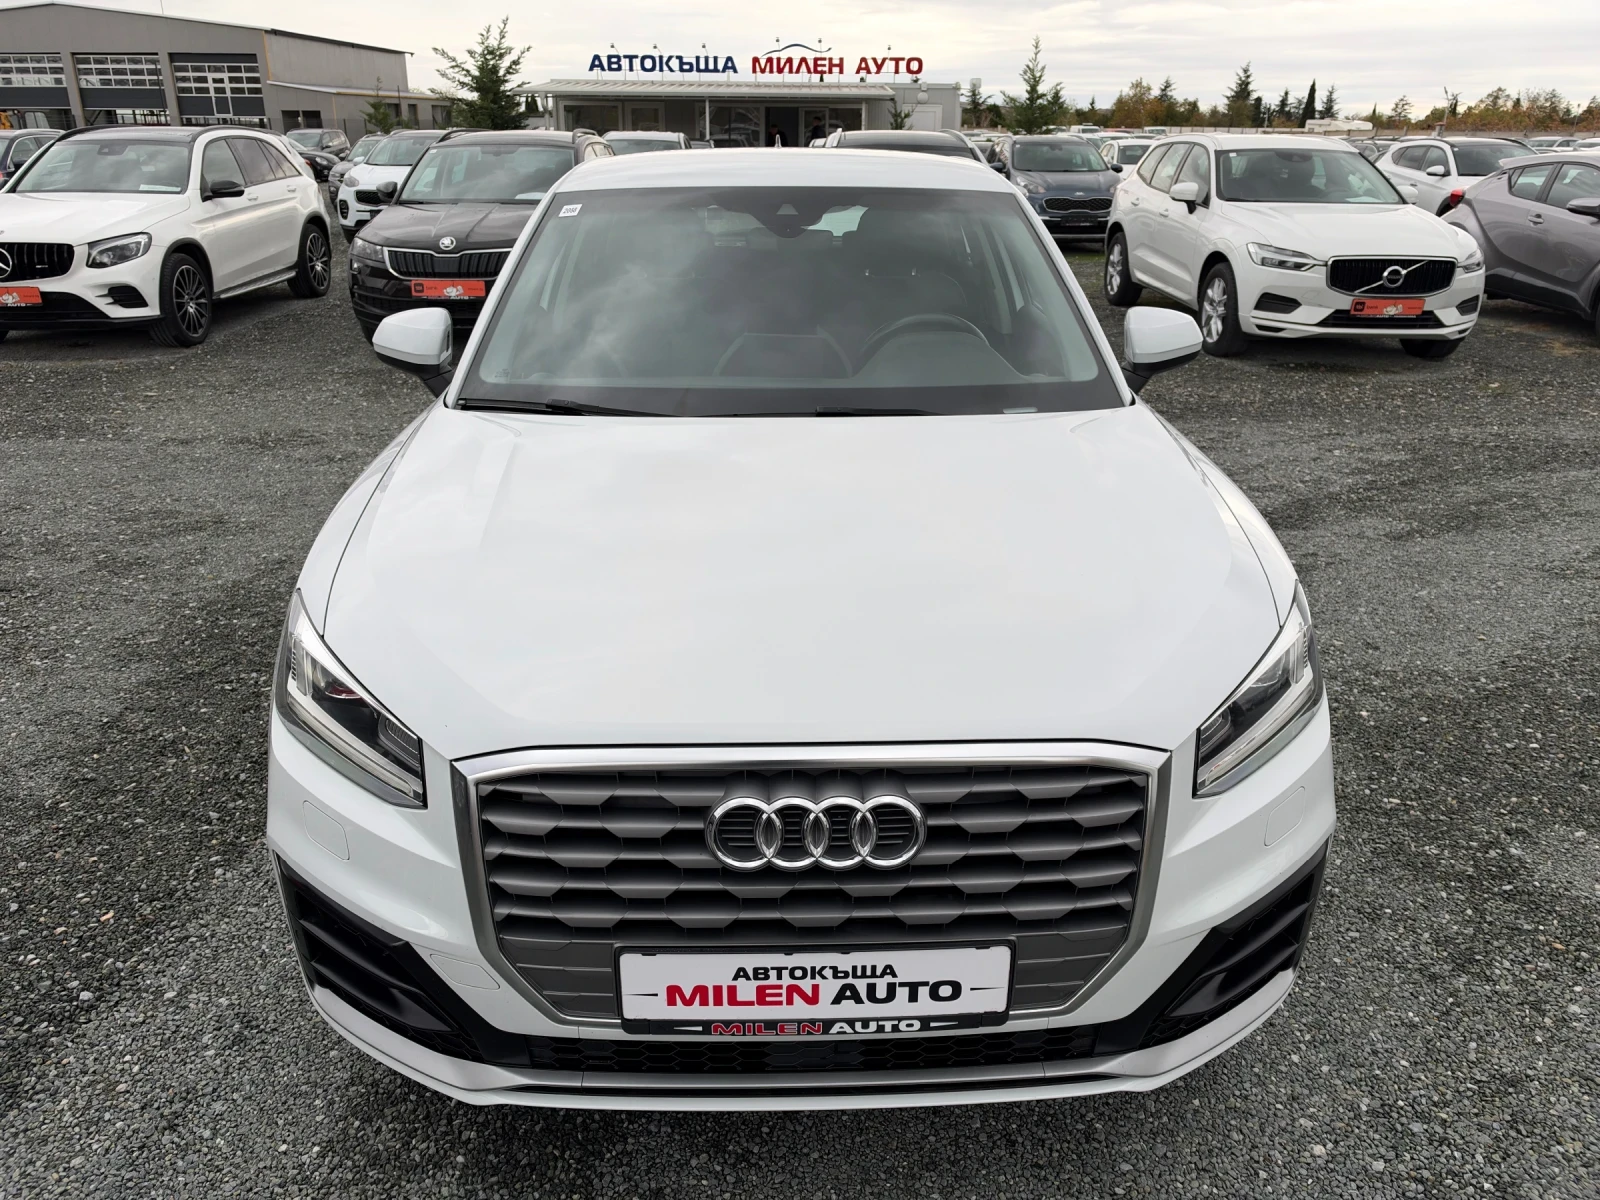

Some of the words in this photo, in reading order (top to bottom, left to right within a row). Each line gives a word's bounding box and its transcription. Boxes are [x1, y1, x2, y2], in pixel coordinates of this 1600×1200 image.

[588, 54, 738, 74] АВТОКЪЩА
[751, 56, 844, 75] МИЛЕН
[855, 57, 923, 75] АУТО
[731, 963, 898, 982] АВТОКЪЩА
[665, 983, 820, 1007] MILEN
[830, 979, 963, 1005] AUTO
[711, 1021, 822, 1036] MILEN
[828, 1019, 922, 1034] AUTO
